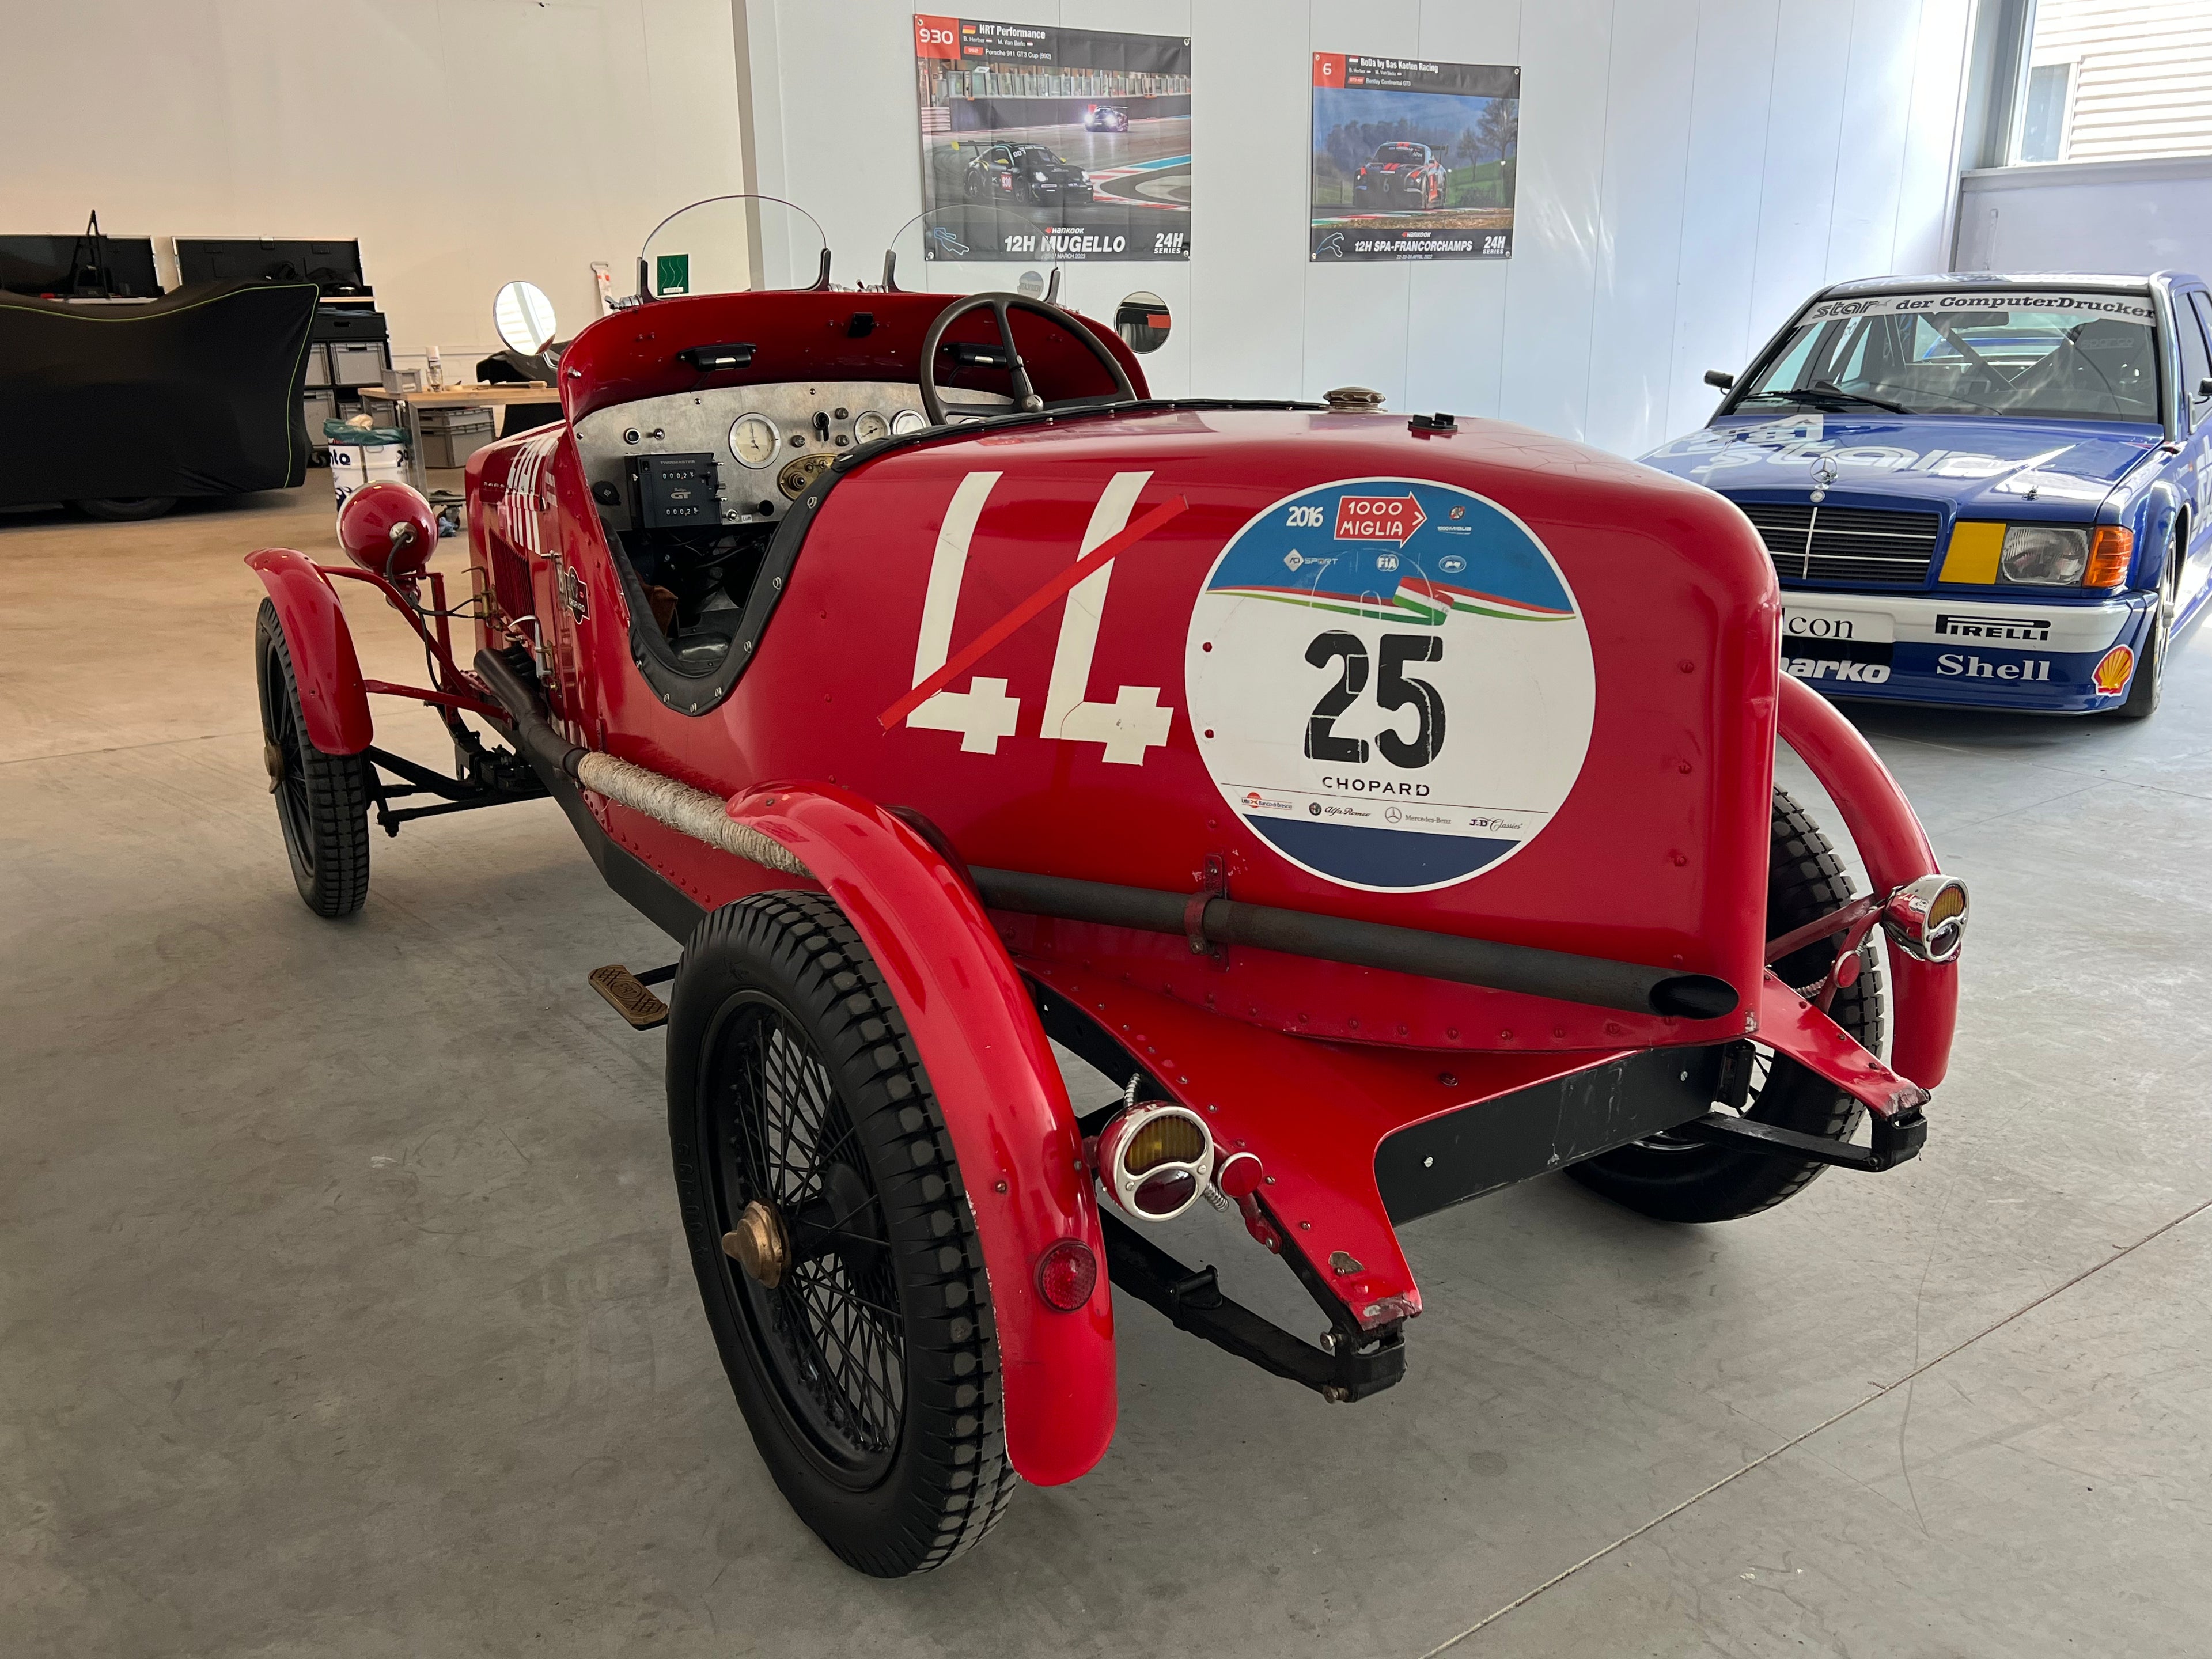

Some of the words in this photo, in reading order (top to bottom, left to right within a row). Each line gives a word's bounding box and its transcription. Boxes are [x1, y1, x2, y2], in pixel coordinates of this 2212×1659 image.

[919, 28, 954, 45] 930
[979, 24, 995, 36] HRT
[996, 26, 1046, 39] Performance
[985, 48, 1006, 56] Porsche
[1323, 63, 1332, 75] 6
[1377, 59, 1384, 69] by
[1385, 60, 1397, 69] Bas
[1398, 61, 1418, 71] Koeten
[1419, 62, 1438, 74] Racing
[1366, 78, 1380, 86] Bentley
[1002, 176, 1012, 188] 930
[1383, 177, 1390, 193] 6
[1005, 236, 1035, 252] 12H
[1040, 236, 1126, 252] MUGELLO
[1154, 233, 1184, 248] 24H
[1354, 241, 1372, 252] 12H
[1373, 240, 1472, 252] SPA-FRANCORCHAMPS
[1483, 236, 1506, 249] 24H
[1813, 300, 1880, 319] star
[1896, 297, 1935, 310] der
[1940, 296, 2156, 319] ComputerDrucker
[670, 491, 691, 499] GT
[1348, 501, 1403, 516] 1000
[1286, 506, 1324, 527] 2016
[1340, 521, 1403, 536] MIGLIA
[1304, 557, 1338, 565] SPORT
[906, 471, 1174, 766] 44
[1935, 613, 2051, 641] PIRELLI
[1937, 654, 2050, 681] Shell
[1304, 630, 1446, 769] 25
[1322, 777, 1430, 797] CHOPARD
[1324, 806, 1343, 816] Alfa
[1343, 808, 1371, 817] Romeo
[1405, 814, 1452, 824] Mercedes-Benz
